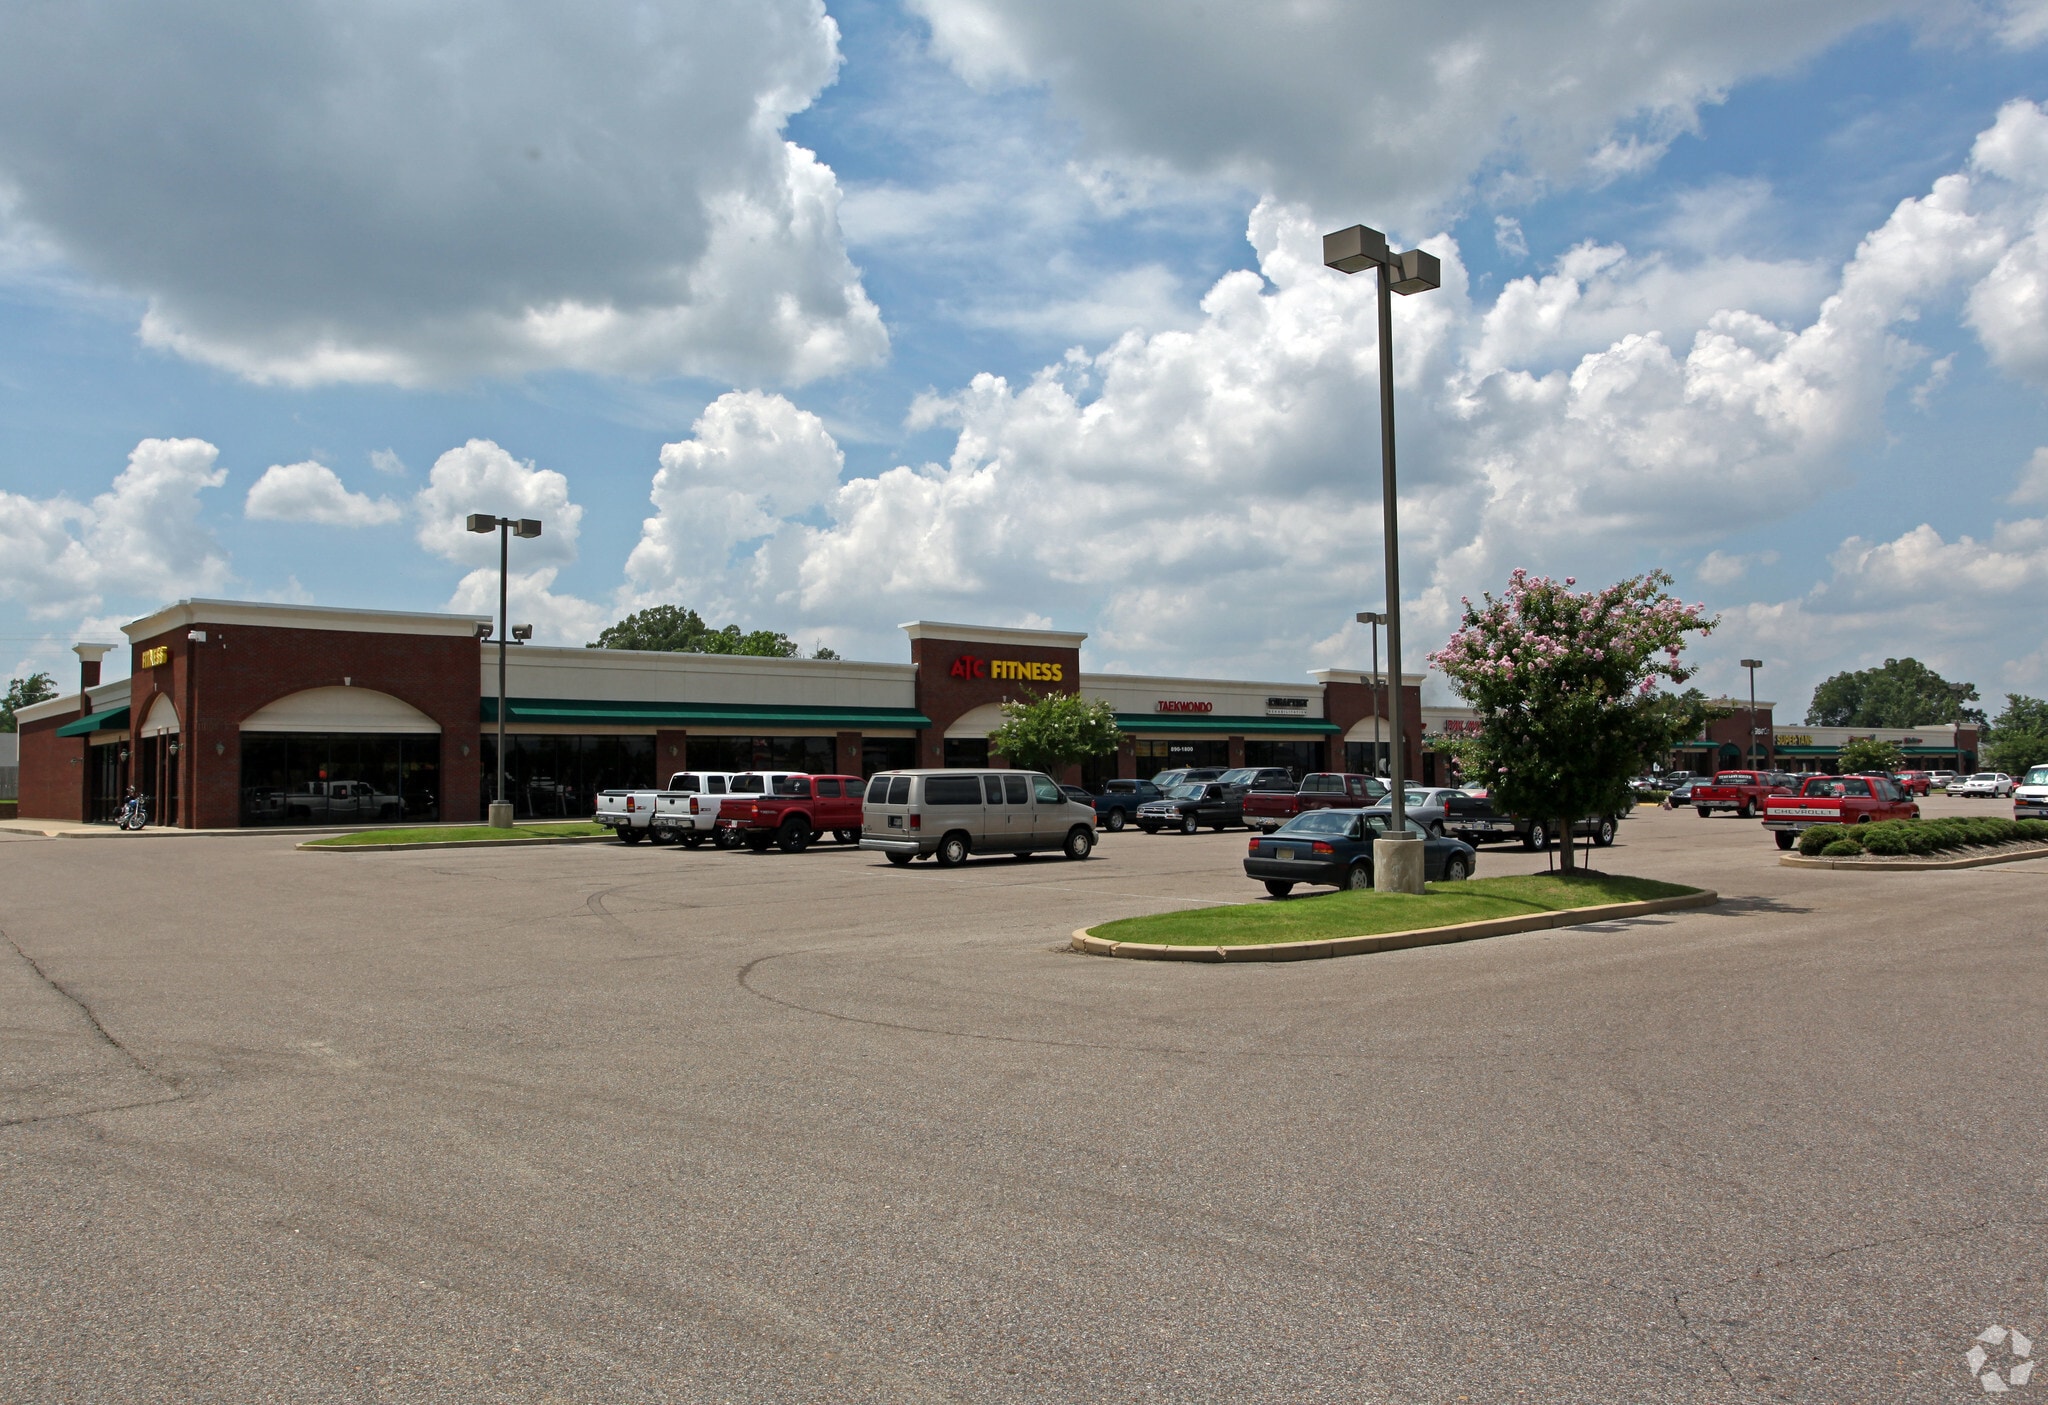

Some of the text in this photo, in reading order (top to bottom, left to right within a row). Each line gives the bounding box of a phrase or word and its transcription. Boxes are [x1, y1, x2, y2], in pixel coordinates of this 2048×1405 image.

[951, 655, 1063, 682] ATC FITNESS
[1157, 701, 1214, 713] TAEKWONDO
[1776, 735, 1813, 746] SUPER TANS
